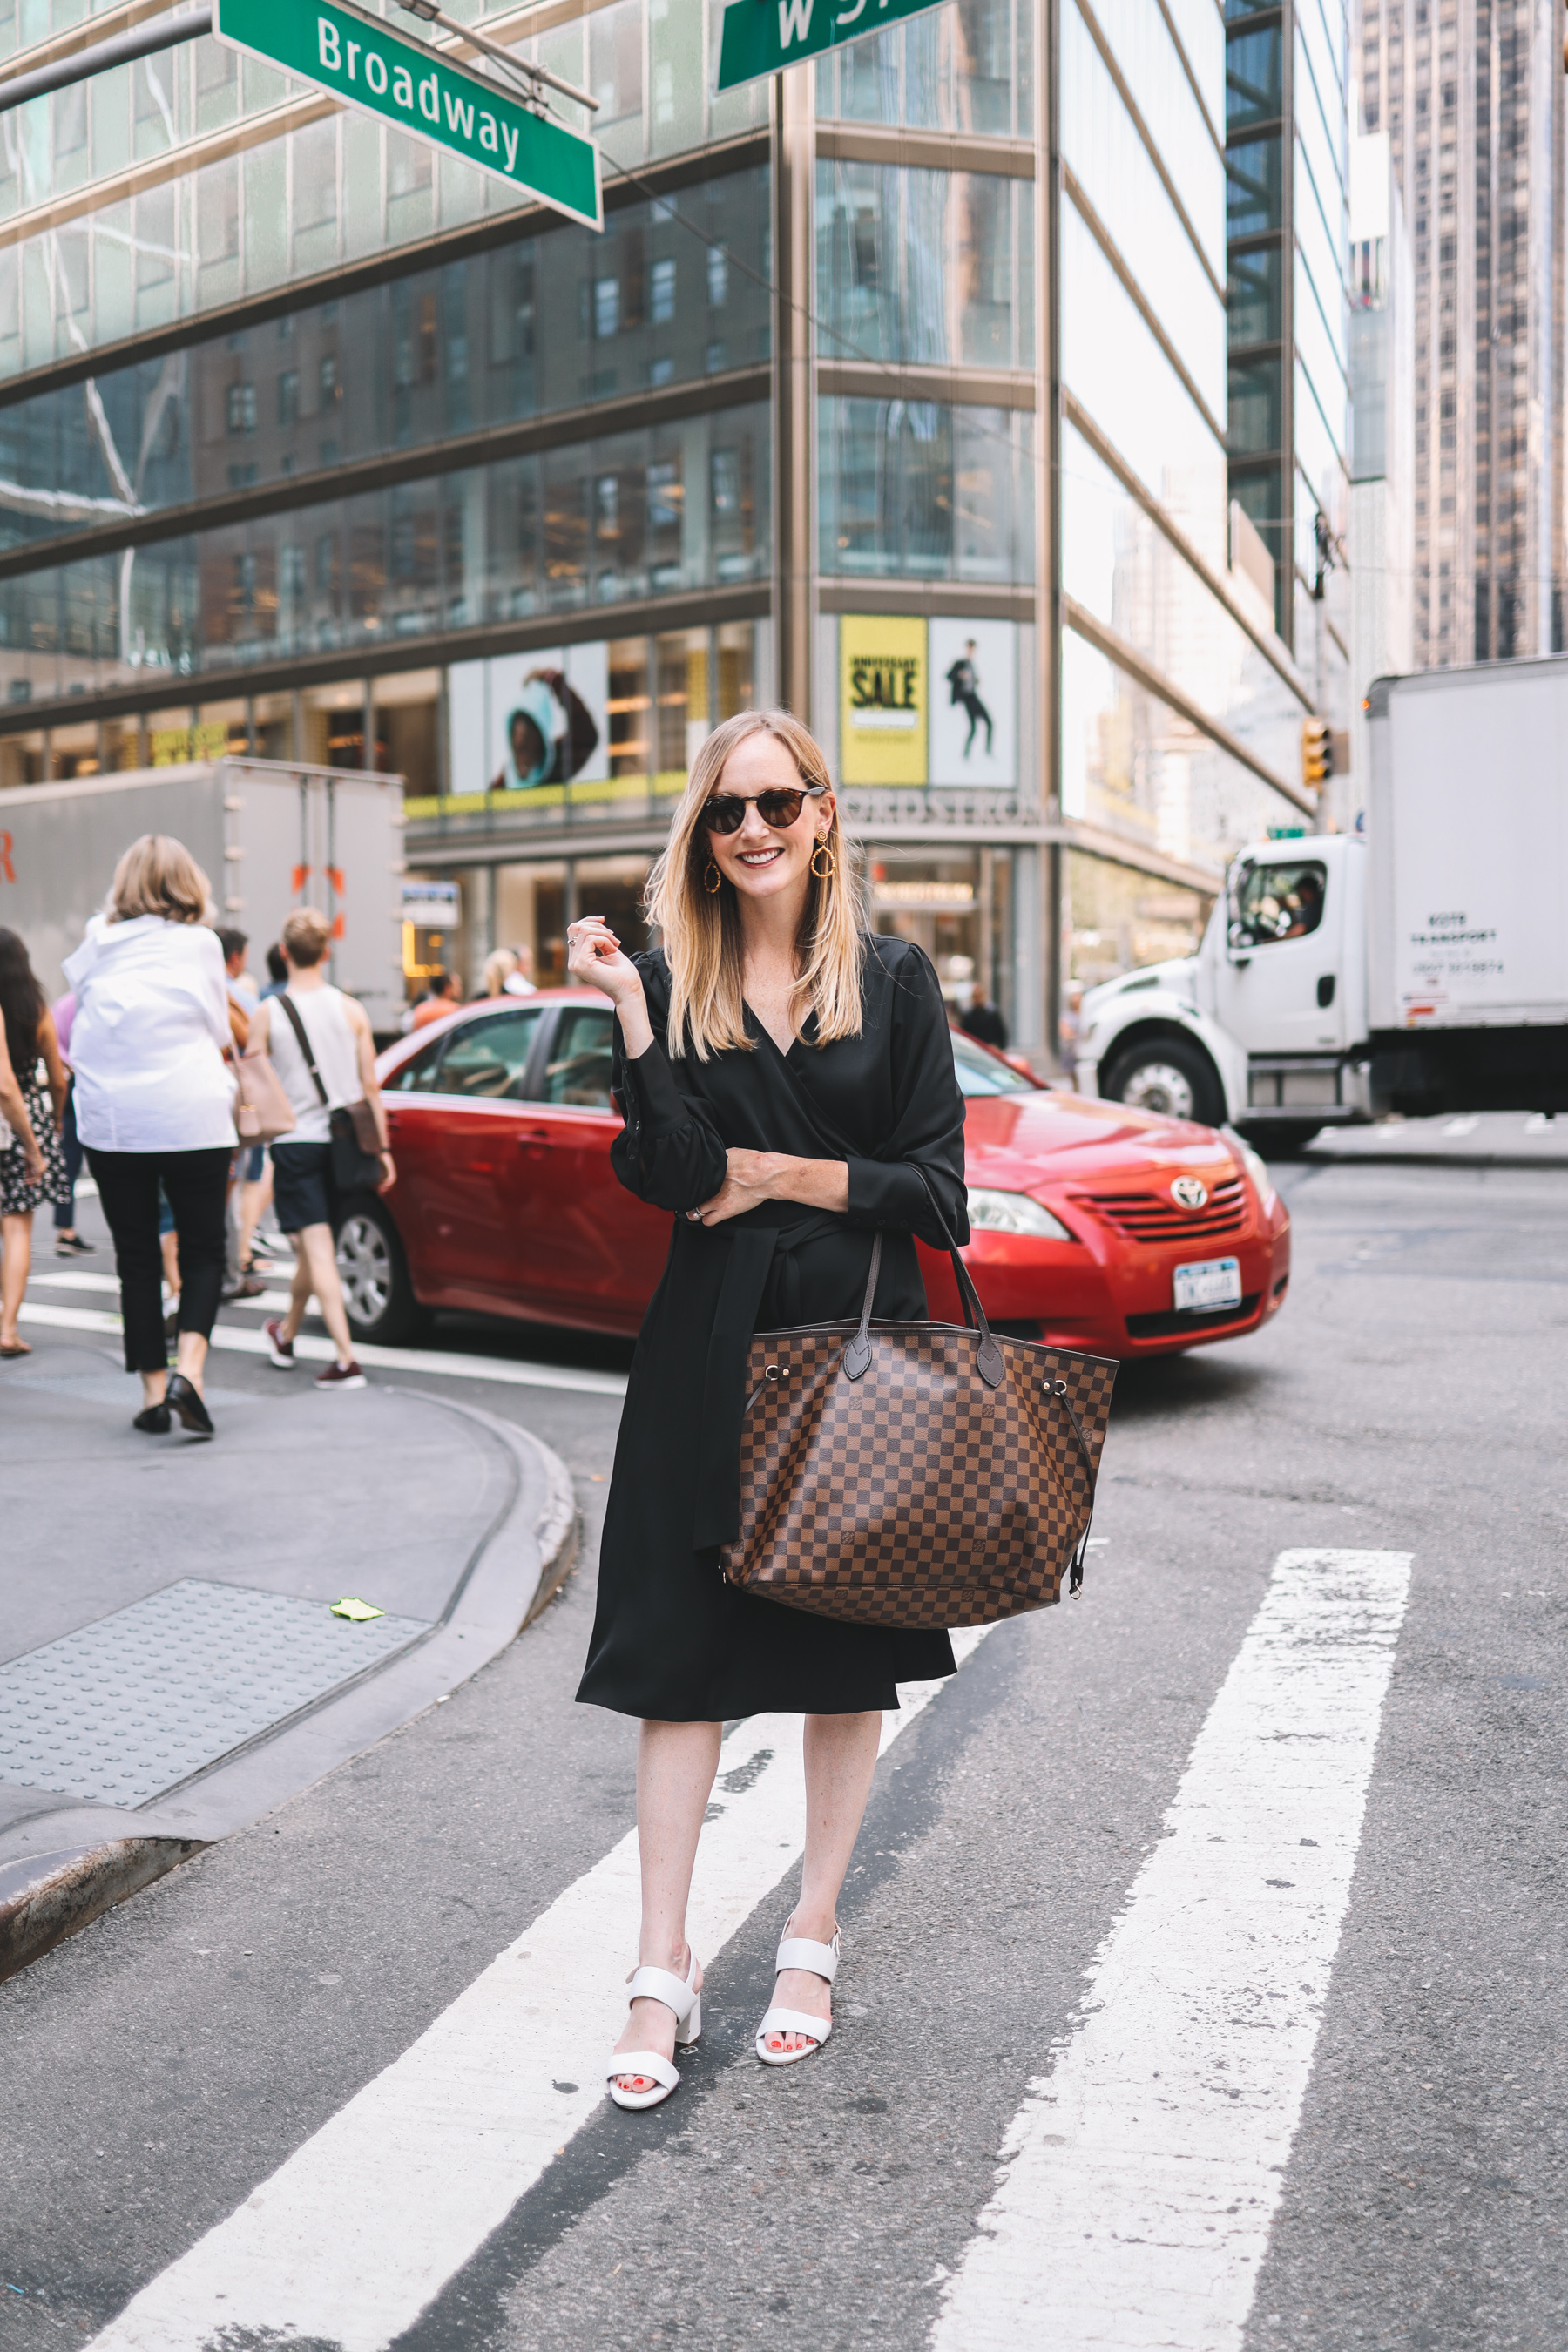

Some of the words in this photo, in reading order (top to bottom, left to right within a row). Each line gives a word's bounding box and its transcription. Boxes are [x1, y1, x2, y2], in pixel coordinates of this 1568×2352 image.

[778, 0, 814, 49] W
[317, 17, 520, 173] Broadway
[851, 669, 917, 708] SALE
